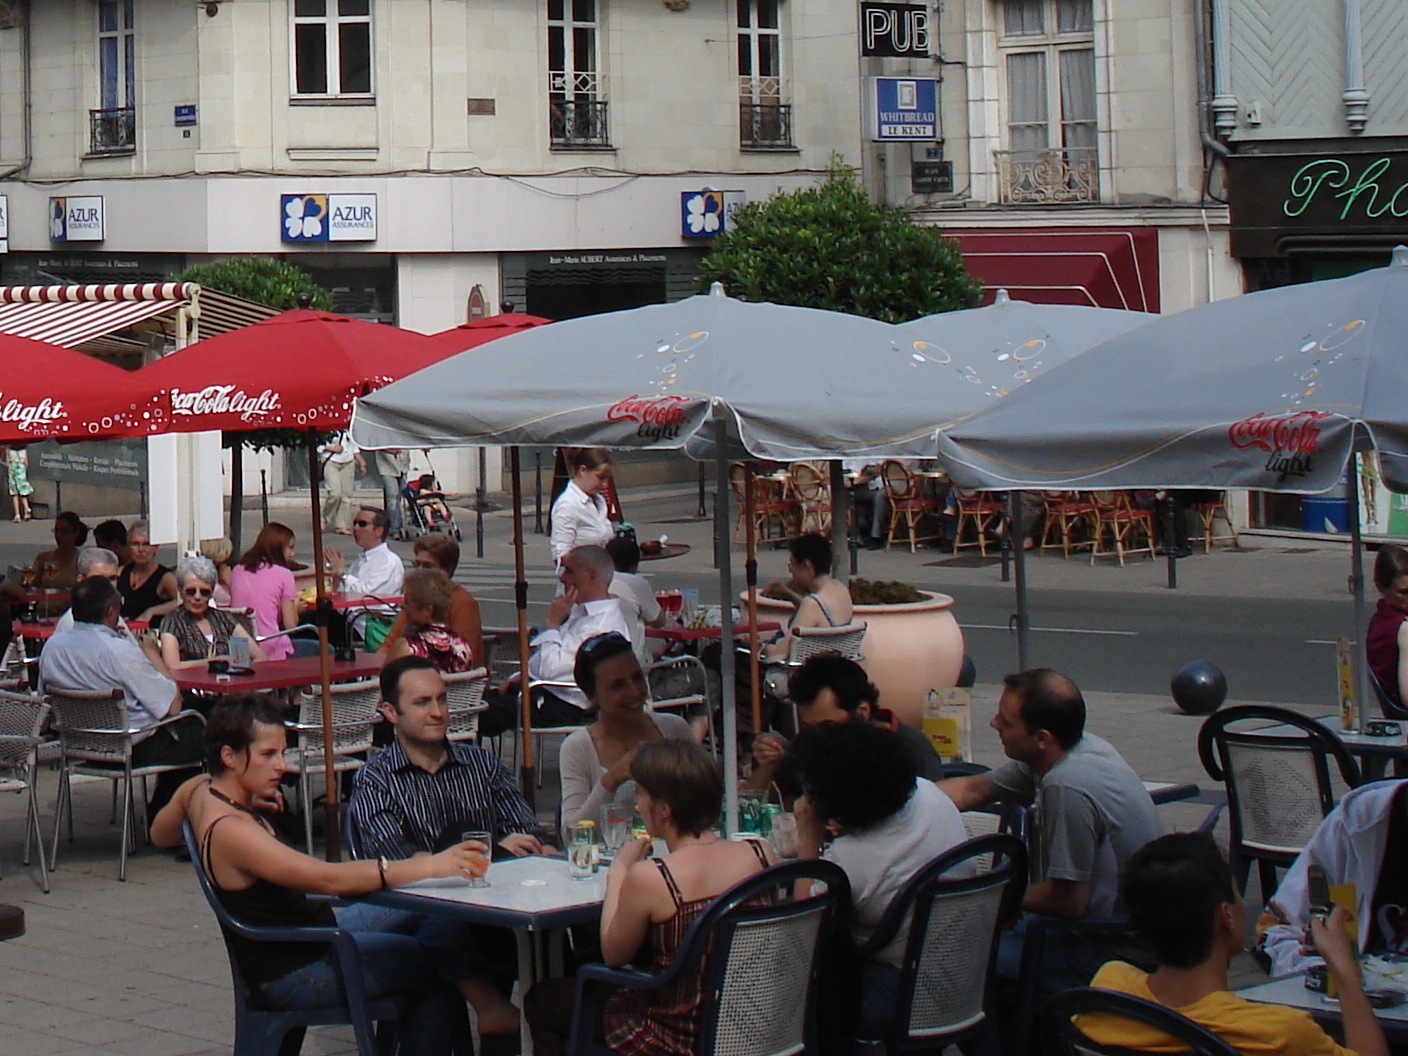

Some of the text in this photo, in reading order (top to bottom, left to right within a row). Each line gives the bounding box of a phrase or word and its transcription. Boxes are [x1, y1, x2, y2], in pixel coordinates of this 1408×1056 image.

[866, 9, 929, 52] PUB
[880, 112, 935, 123] WHITBREAD
[888, 126, 927, 135] LE KENT
[69, 208, 99, 222] AZUR
[332, 206, 373, 221] AZUR
[332, 221, 374, 229] ASSURANCES
[171, 384, 281, 421] oca-Cola light
[2, 398, 65, 430] light
[637, 423, 681, 442] light
[1265, 449, 1314, 483] light
